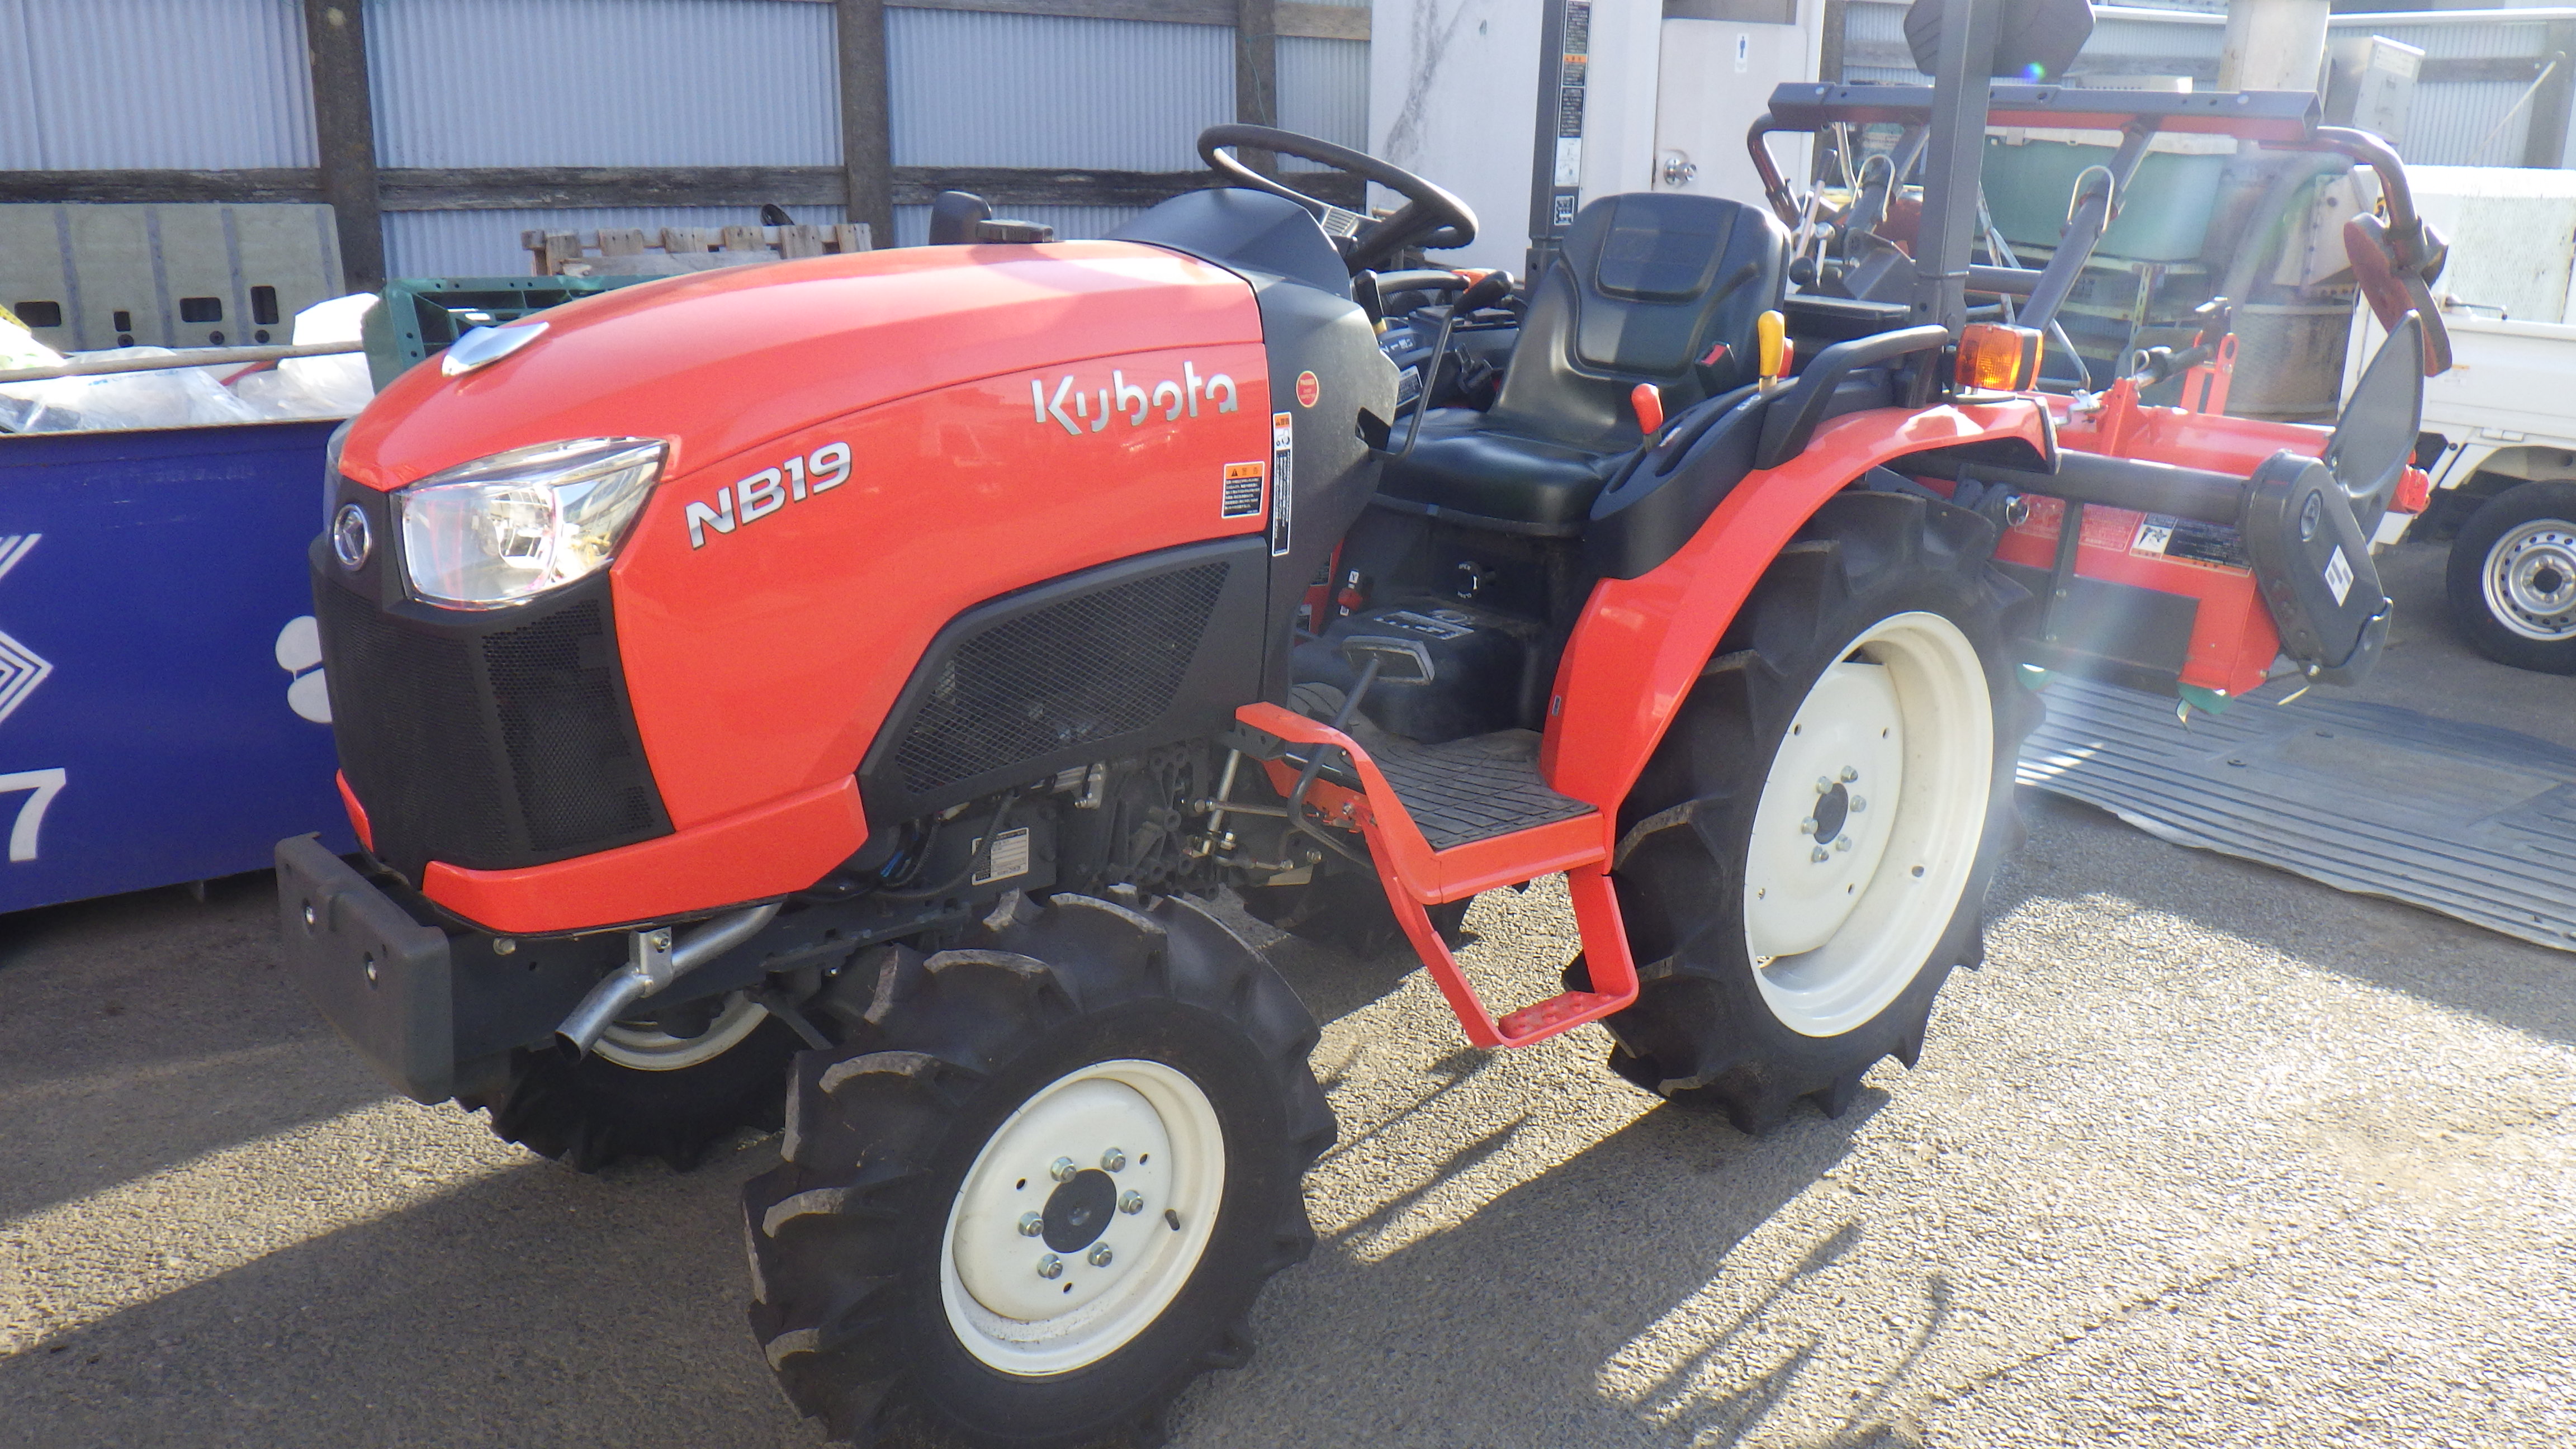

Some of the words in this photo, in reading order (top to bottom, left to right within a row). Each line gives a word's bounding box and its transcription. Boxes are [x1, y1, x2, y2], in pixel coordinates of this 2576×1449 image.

[1031, 361, 1237, 435] Kubota
[685, 442, 851, 550] NB19
[0, 768, 66, 861] 7
